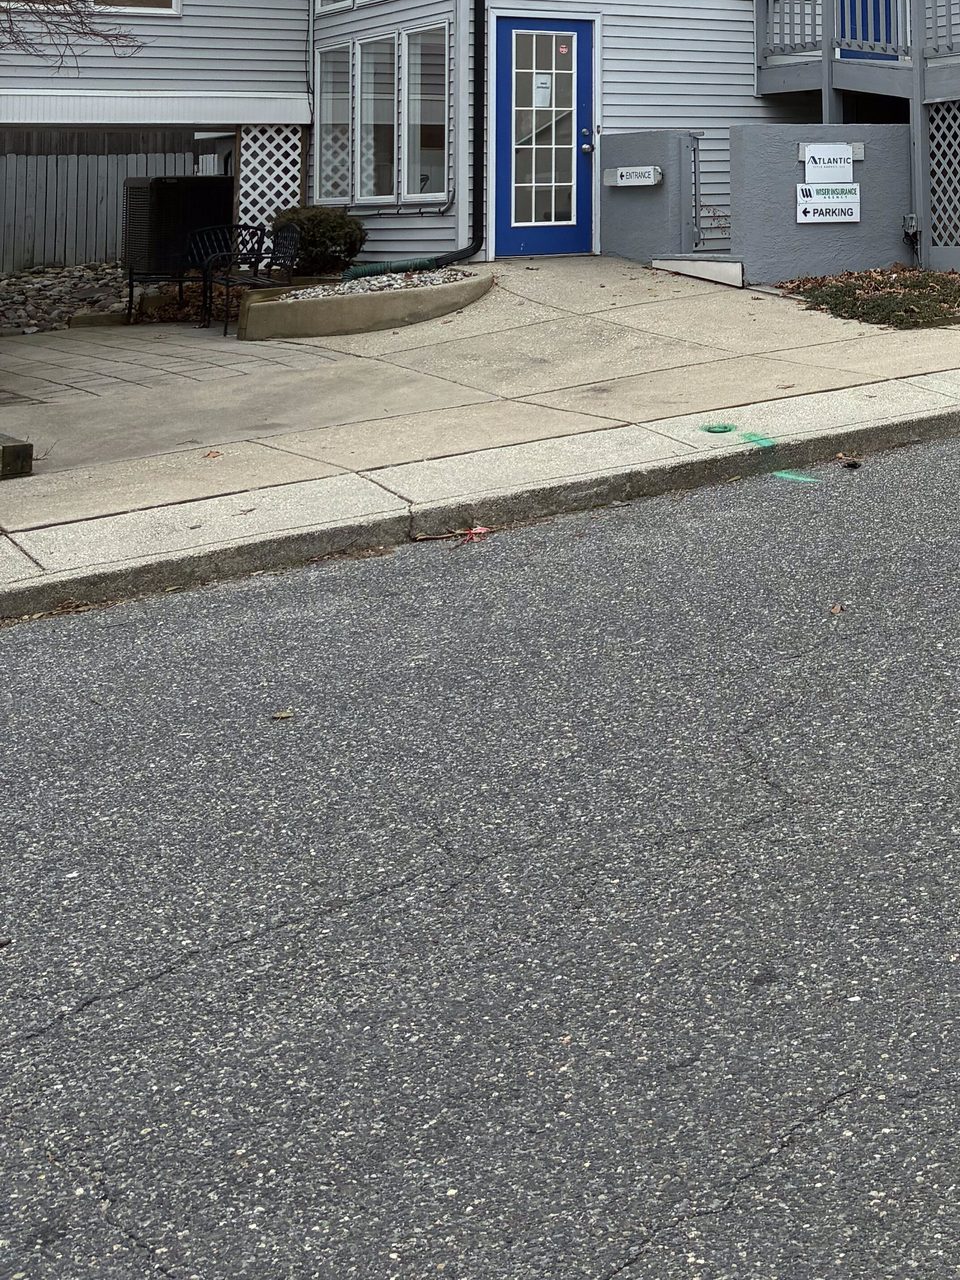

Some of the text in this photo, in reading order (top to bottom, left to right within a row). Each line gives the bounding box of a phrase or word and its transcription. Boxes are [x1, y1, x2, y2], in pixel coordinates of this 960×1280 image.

[807, 156, 851, 165] ATLANTIC
[626, 171, 651, 180] ENTRANCE
[812, 208, 854, 217] PARKING
